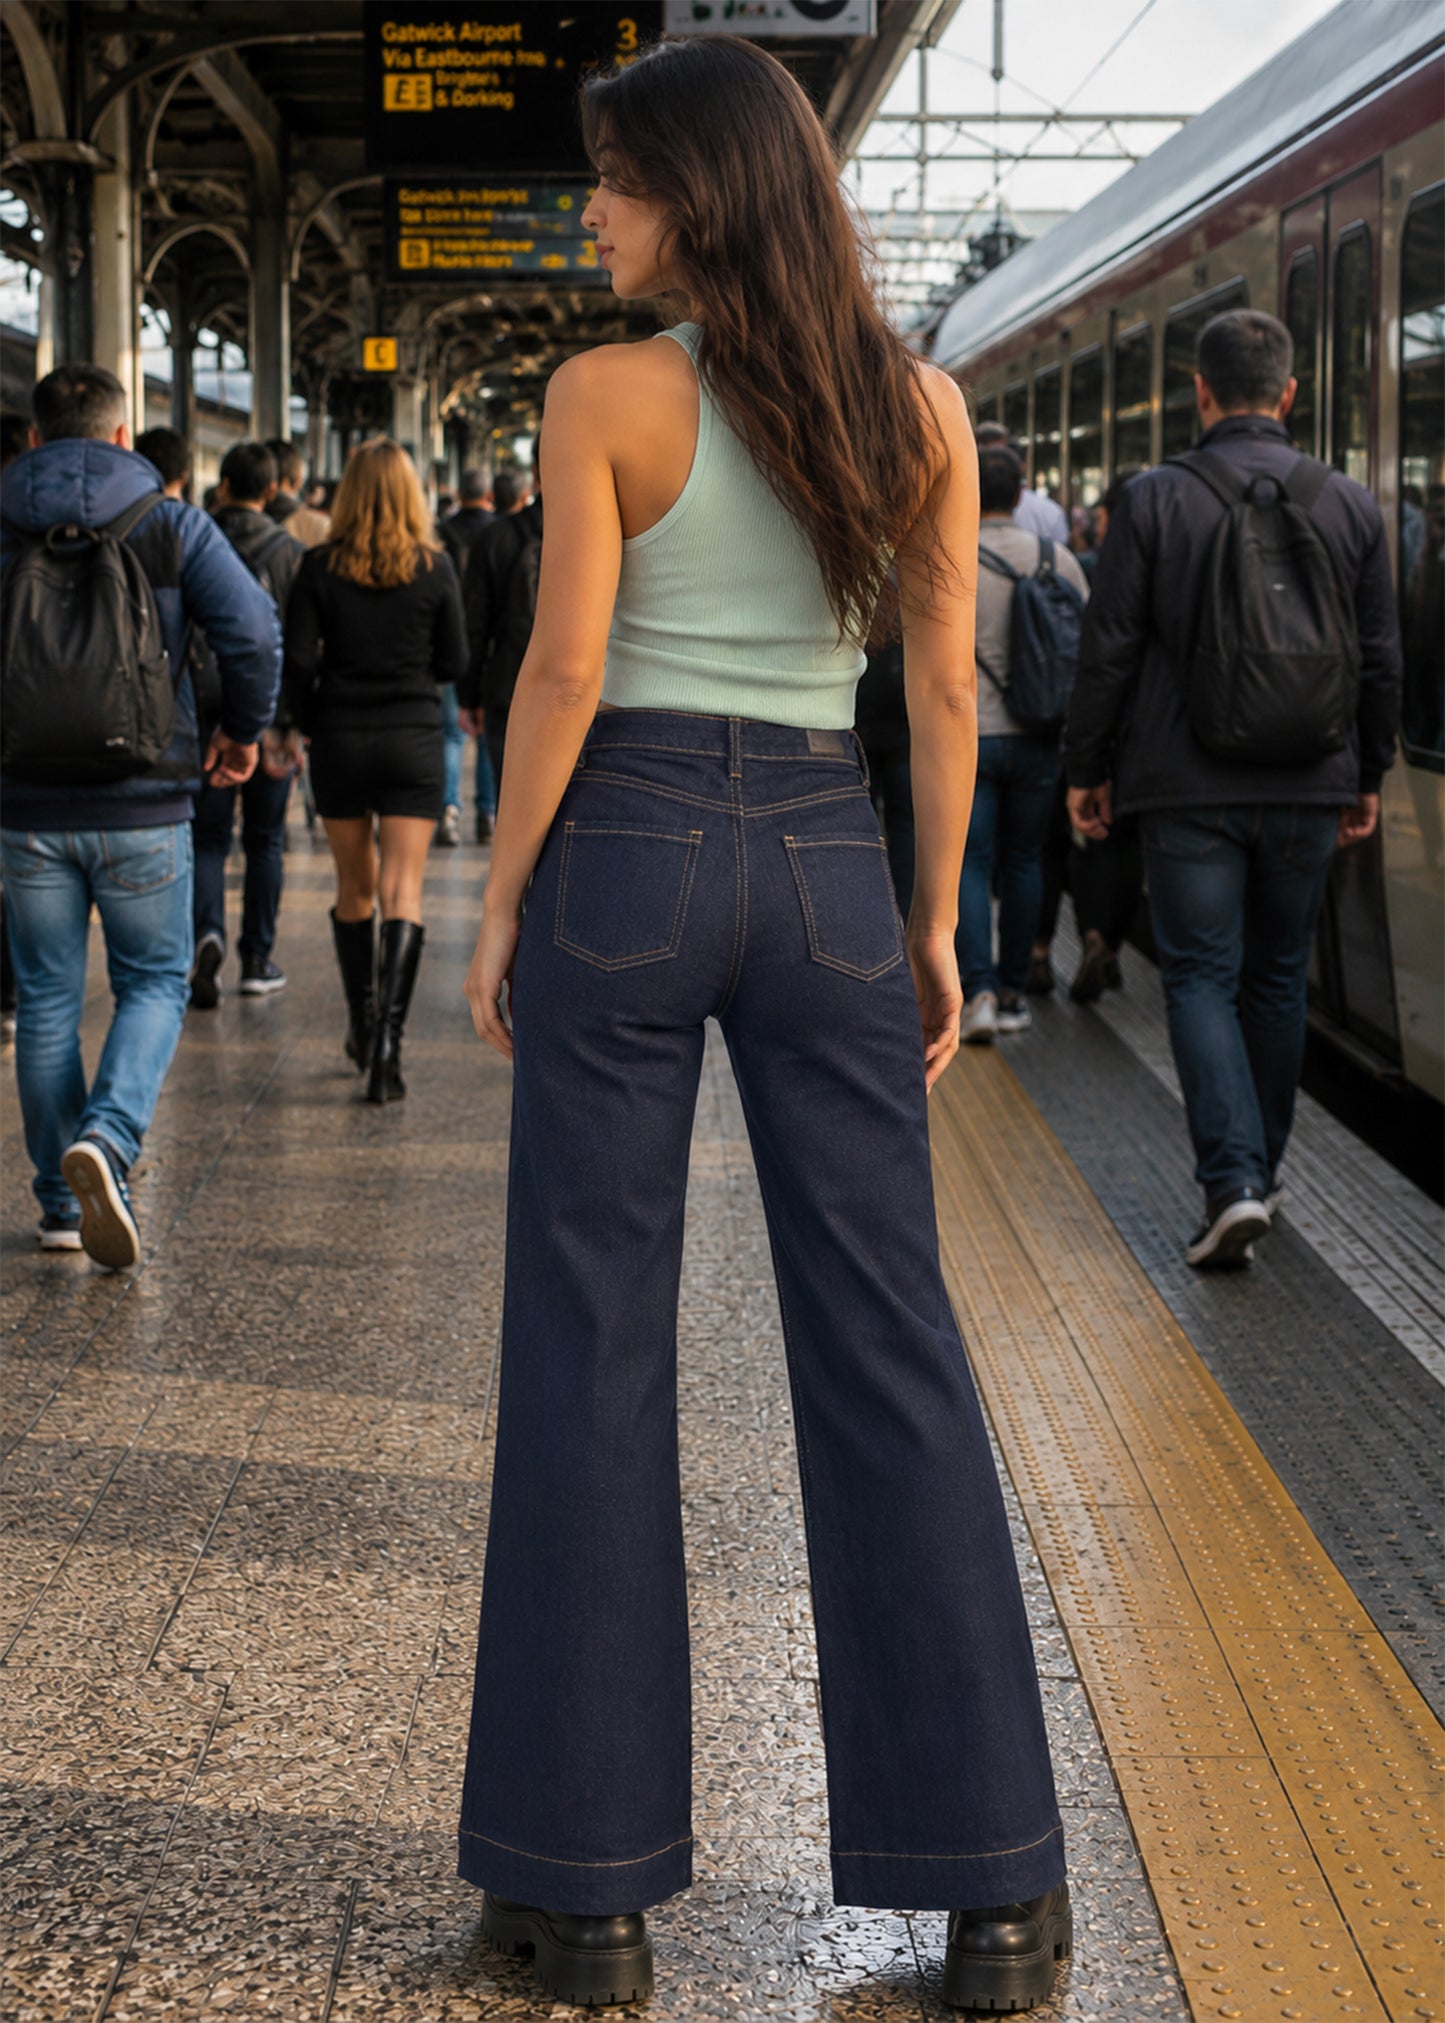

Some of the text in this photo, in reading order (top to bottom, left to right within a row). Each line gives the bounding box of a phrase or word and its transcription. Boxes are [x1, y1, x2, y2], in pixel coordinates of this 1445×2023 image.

[381, 21, 522, 45] Gatwick Airport
[617, 18, 638, 50] 3
[382, 48, 411, 68] Via
[415, 48, 512, 68] Eastbourne
[452, 89, 514, 110] Dorking
